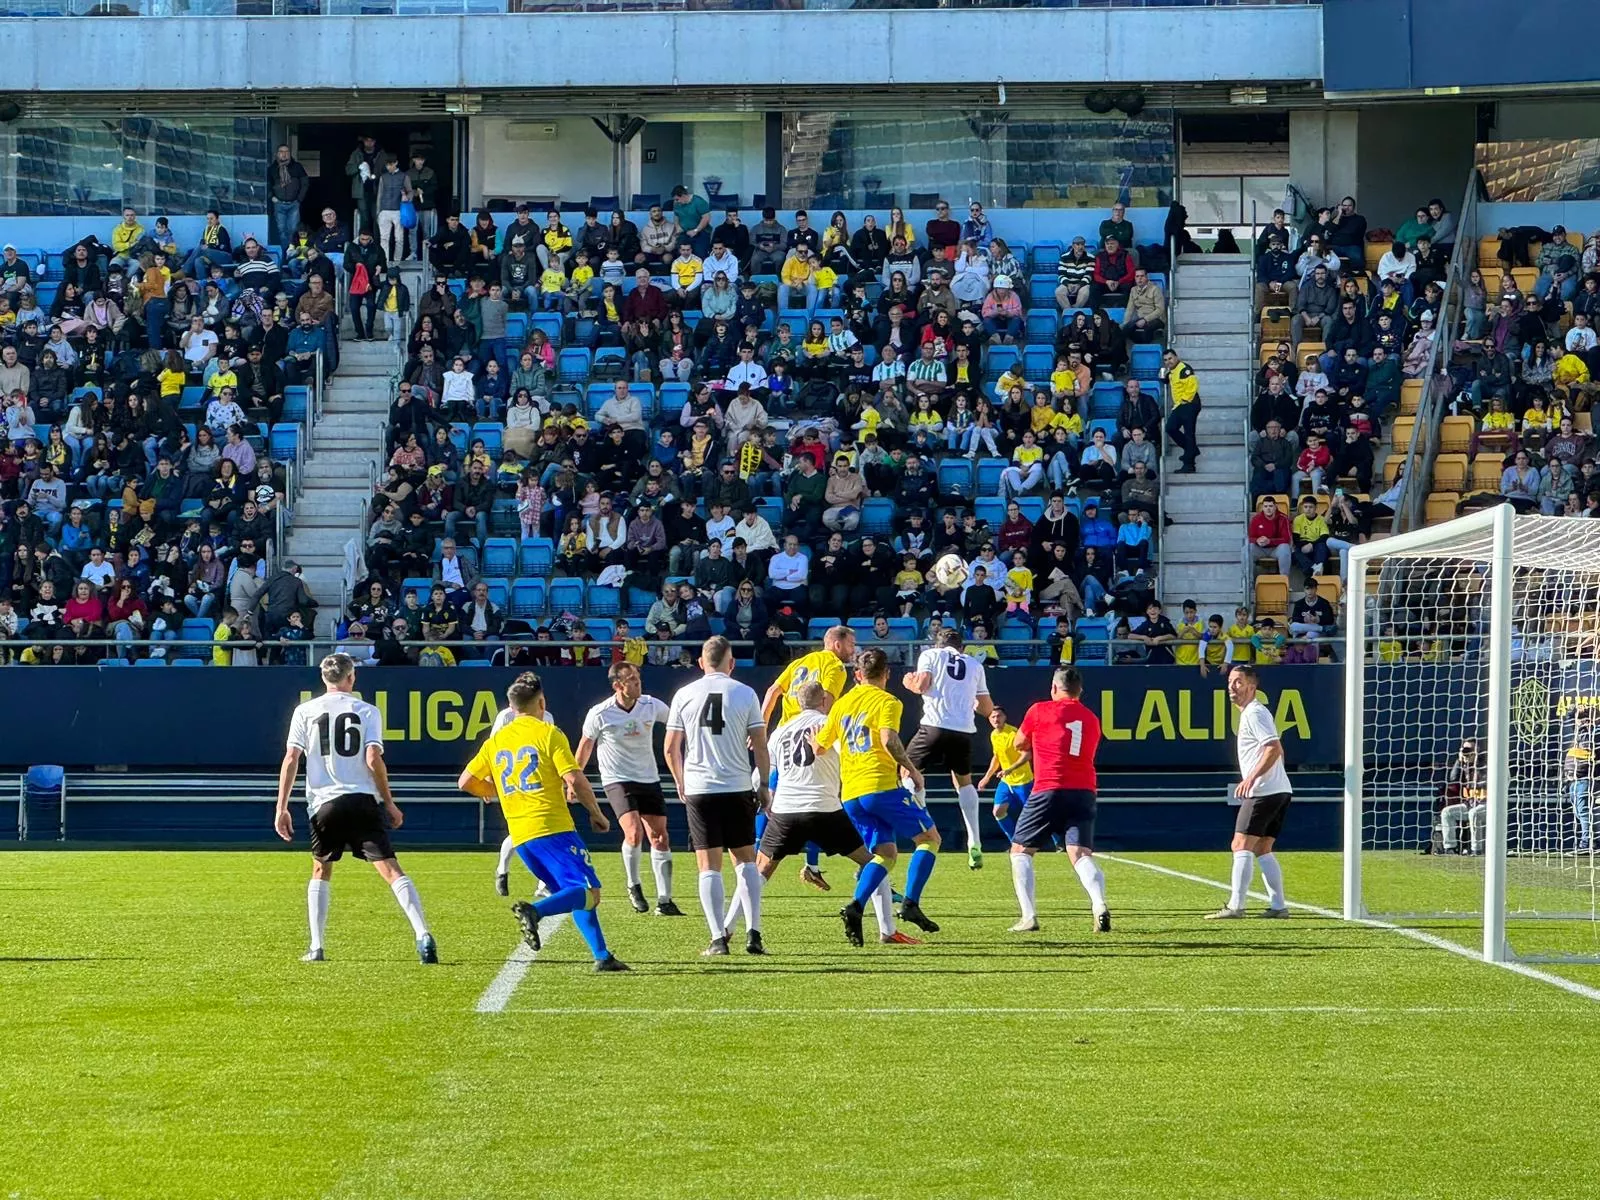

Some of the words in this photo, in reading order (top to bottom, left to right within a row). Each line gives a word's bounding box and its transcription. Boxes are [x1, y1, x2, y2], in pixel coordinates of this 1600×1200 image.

[946, 652, 967, 681] 5
[300, 690, 500, 741] LIGA
[312, 712, 362, 757] 16
[700, 693, 726, 735] 4
[1065, 720, 1083, 757] 1
[495, 745, 544, 795] 22
